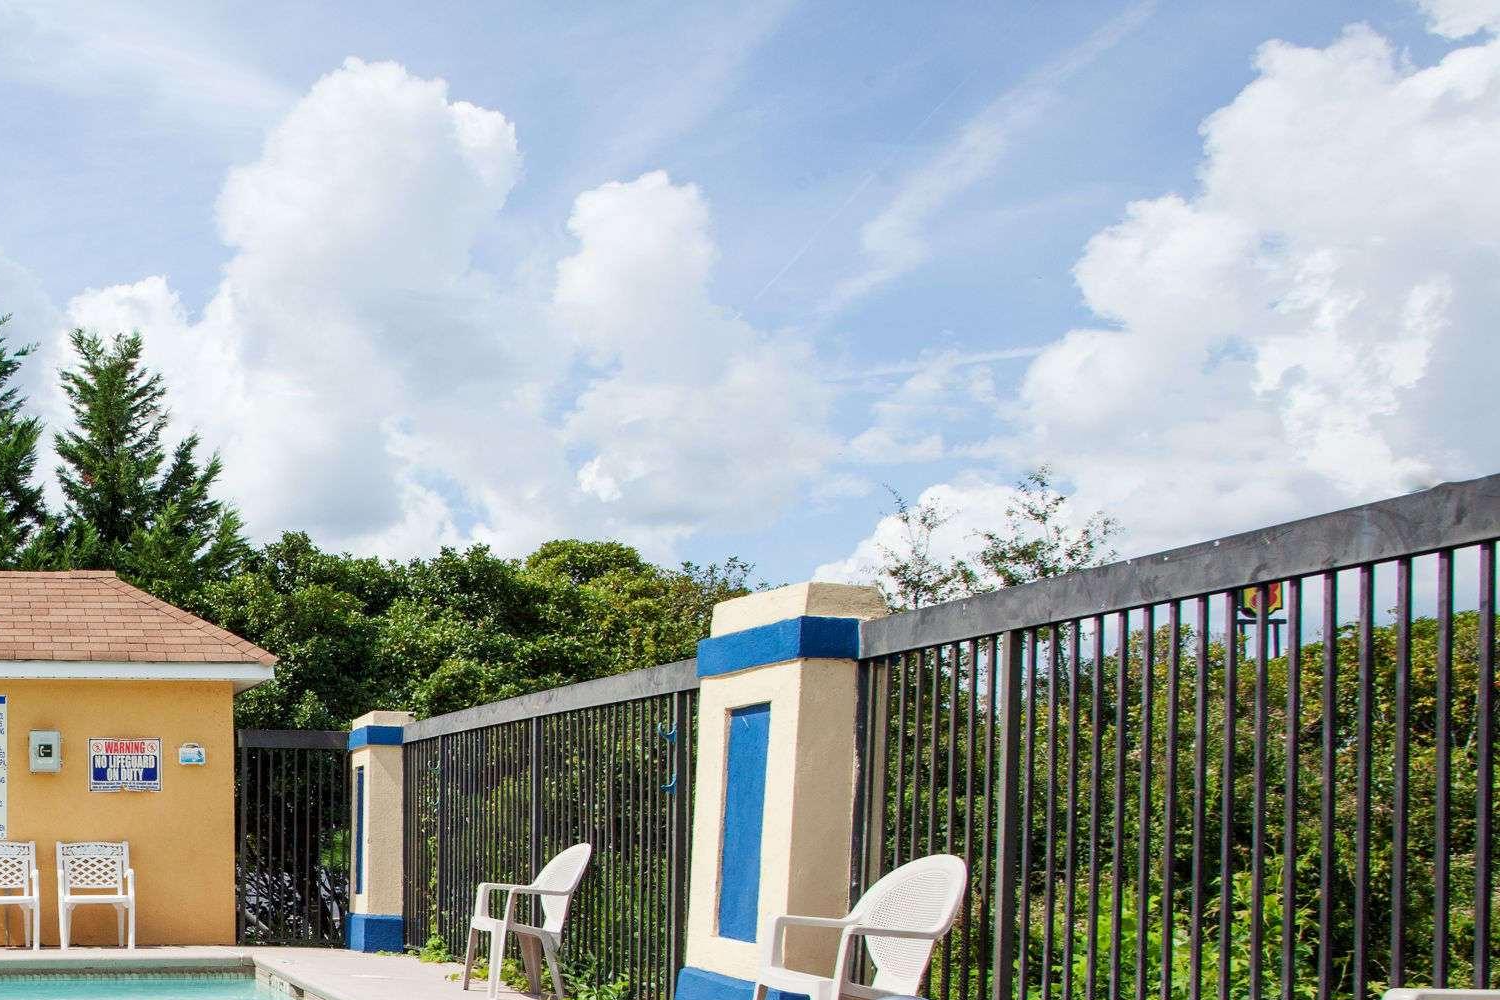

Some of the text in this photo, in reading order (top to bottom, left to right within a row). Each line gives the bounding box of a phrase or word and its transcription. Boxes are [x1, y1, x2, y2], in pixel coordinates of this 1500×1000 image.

[104, 742, 146, 754] WARNING
[94, 756, 155, 768] NO LIFEGUARD
[106, 768, 144, 780] ON DUTY
